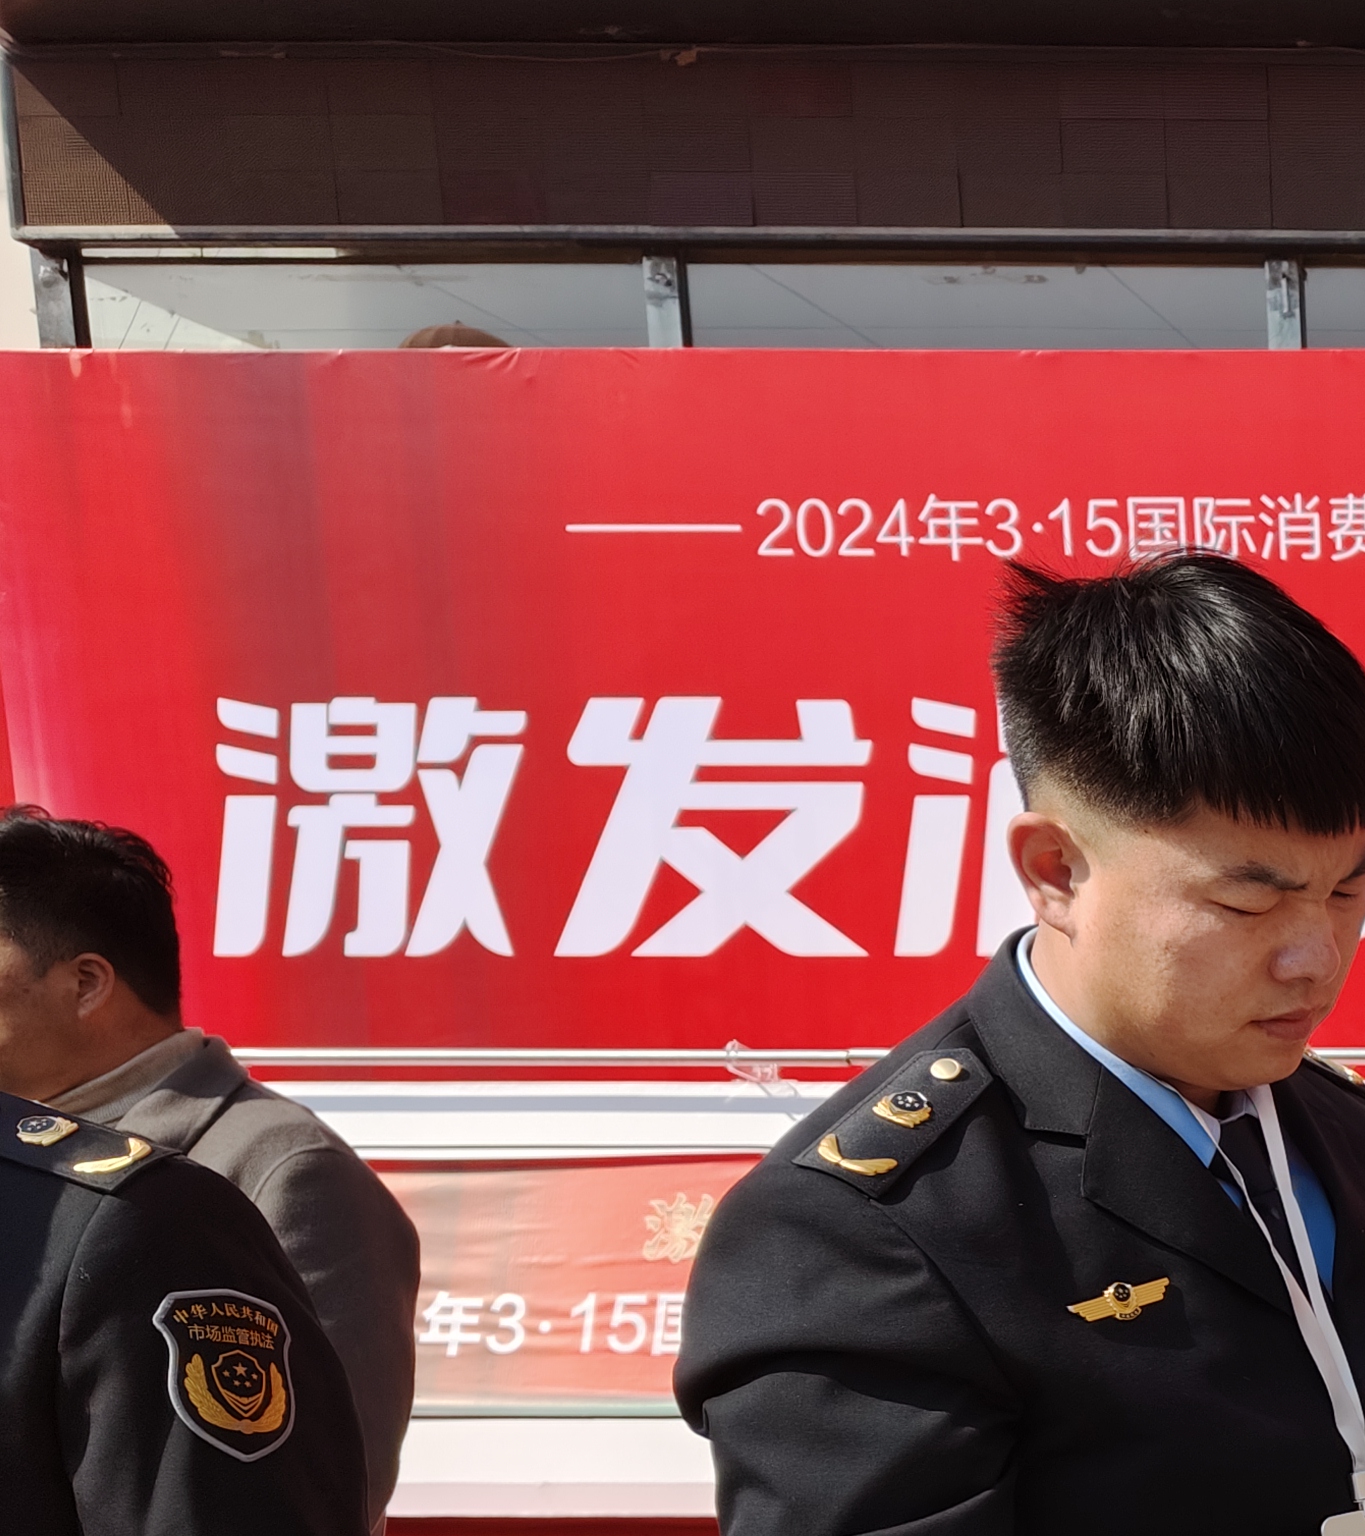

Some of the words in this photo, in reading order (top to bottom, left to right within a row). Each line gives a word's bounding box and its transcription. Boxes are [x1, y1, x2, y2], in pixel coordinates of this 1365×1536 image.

[172, 1302, 279, 1337] 中华人民共和国
[187, 1324, 275, 1350] 市场监管执法
